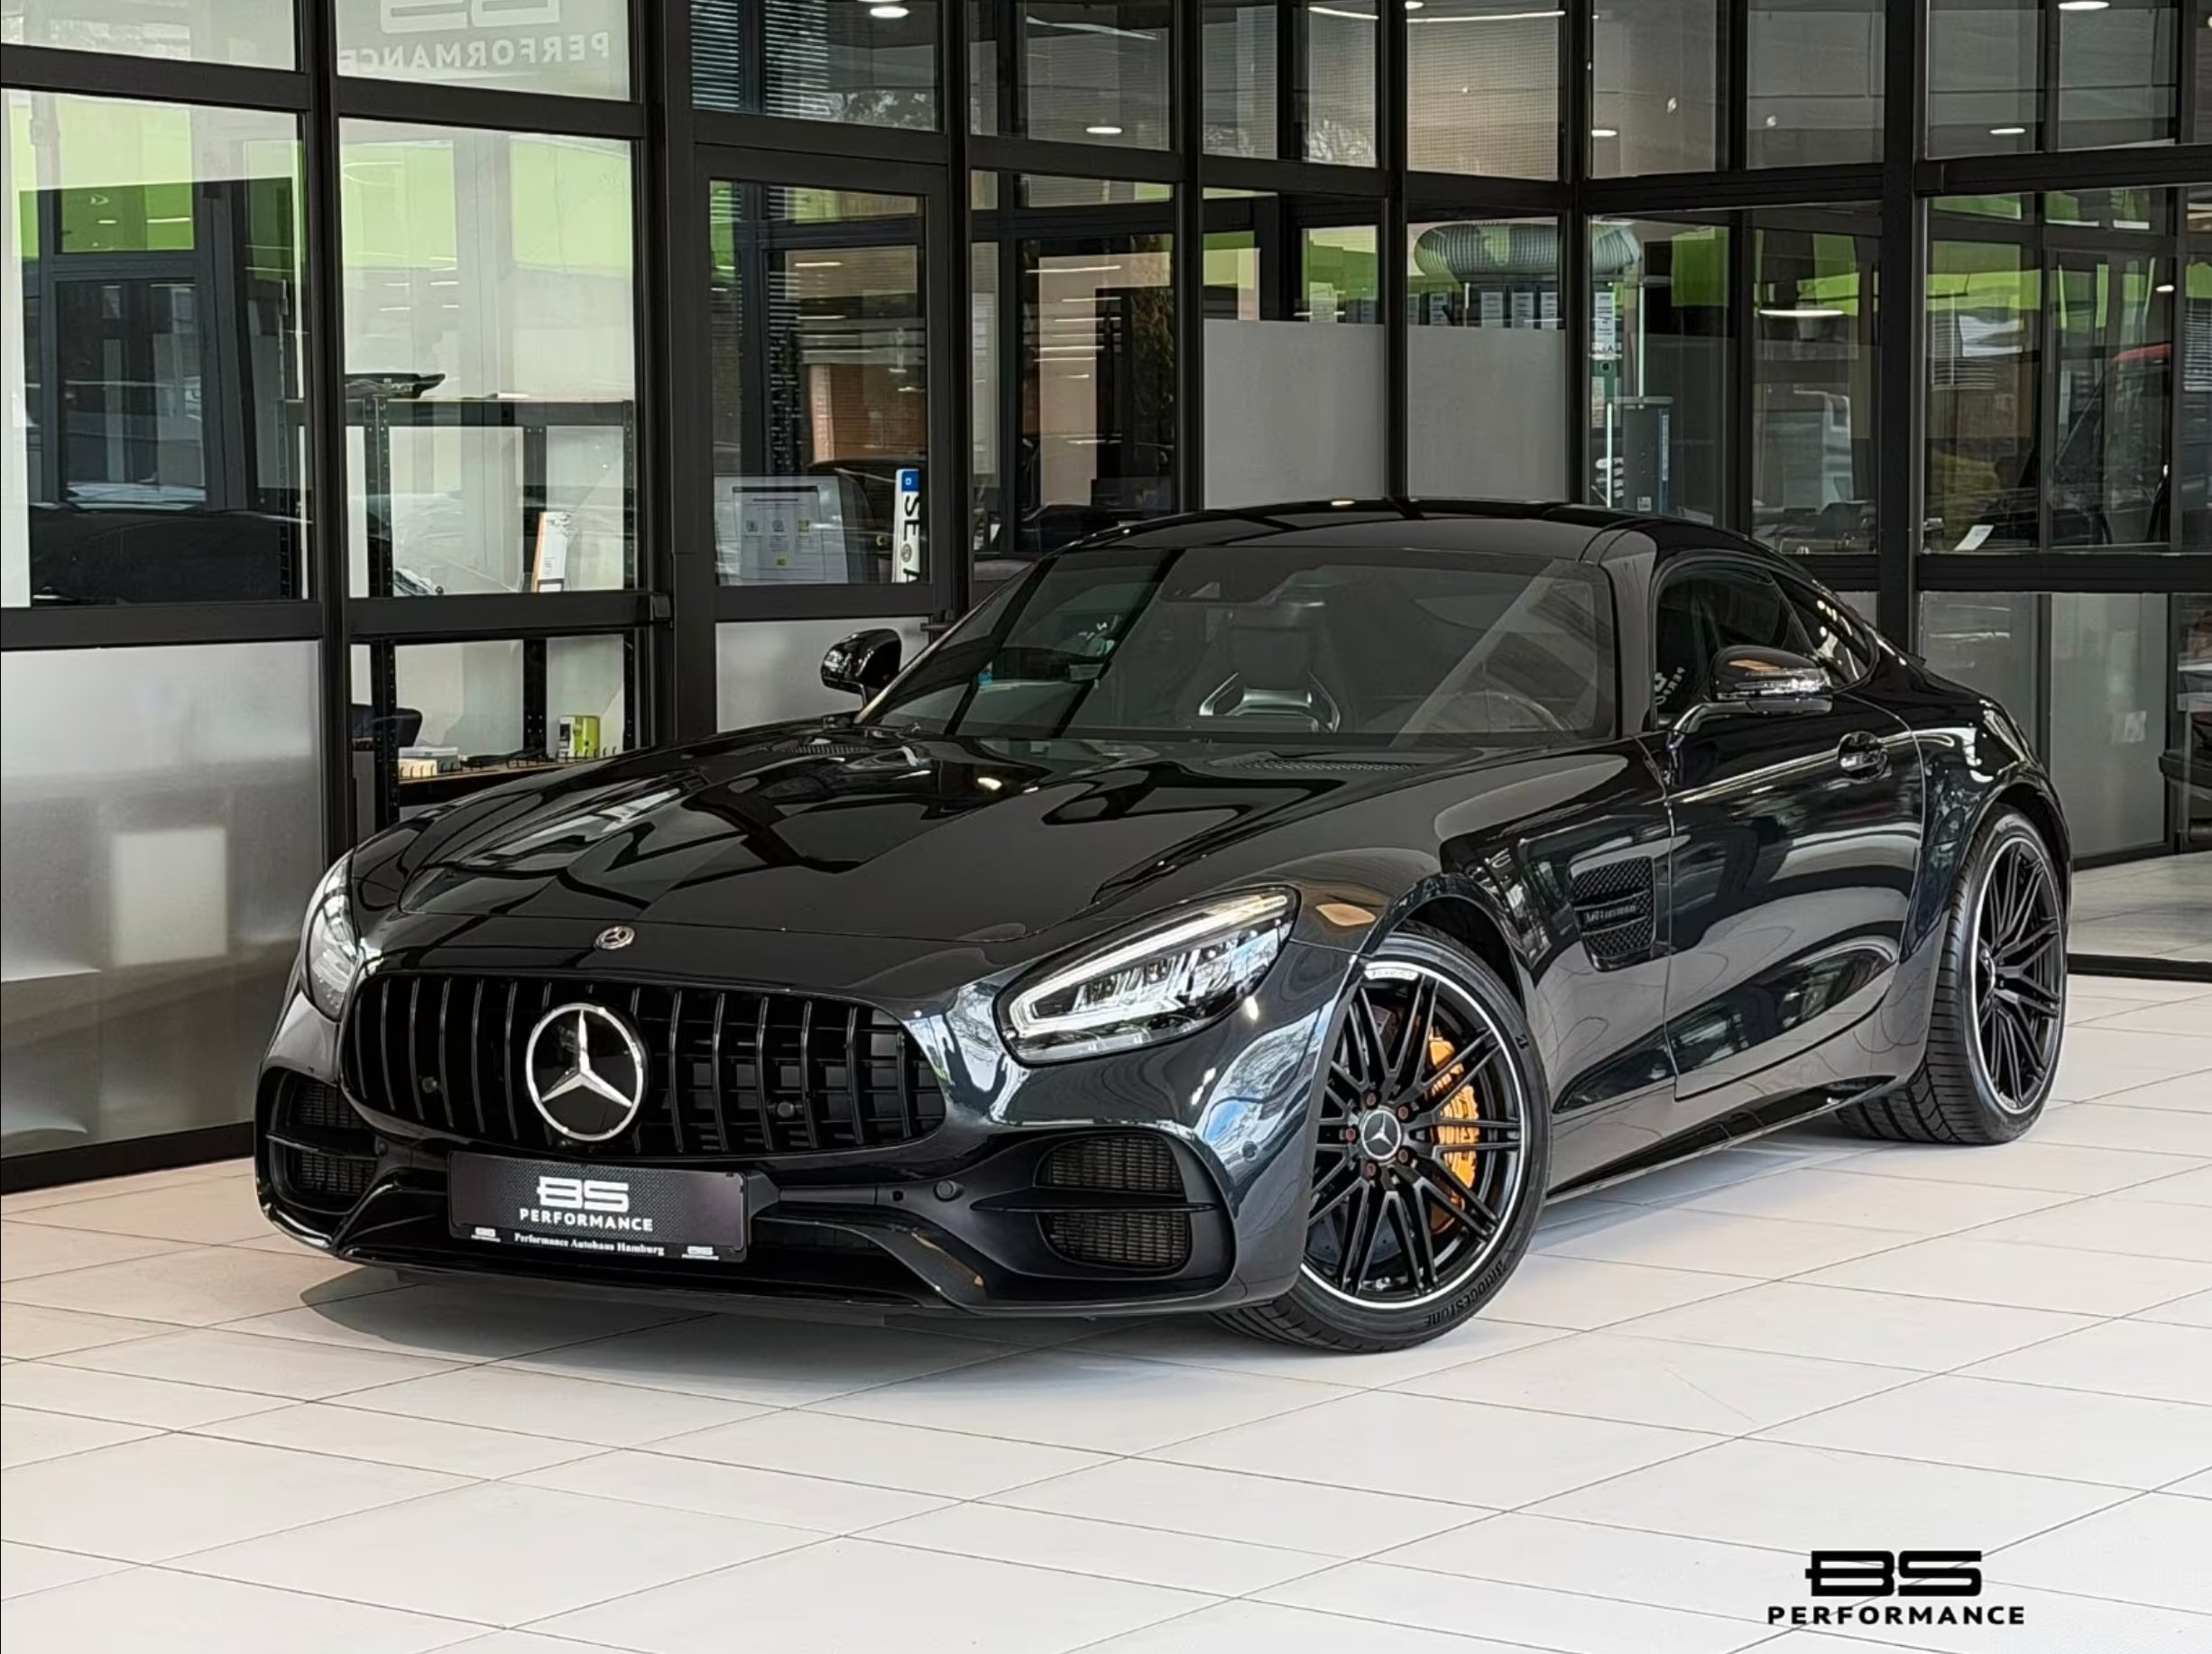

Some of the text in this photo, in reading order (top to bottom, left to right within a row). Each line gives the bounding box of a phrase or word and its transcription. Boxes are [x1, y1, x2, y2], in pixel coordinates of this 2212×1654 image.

[904, 495, 920, 541] SE
[537, 1176, 630, 1213] BS
[519, 1208, 654, 1231] PERFORMANCE
[514, 1232, 569, 1247] Performance
[570, 1238, 614, 1252] Autohaus
[616, 1242, 665, 1257] Hamburg
